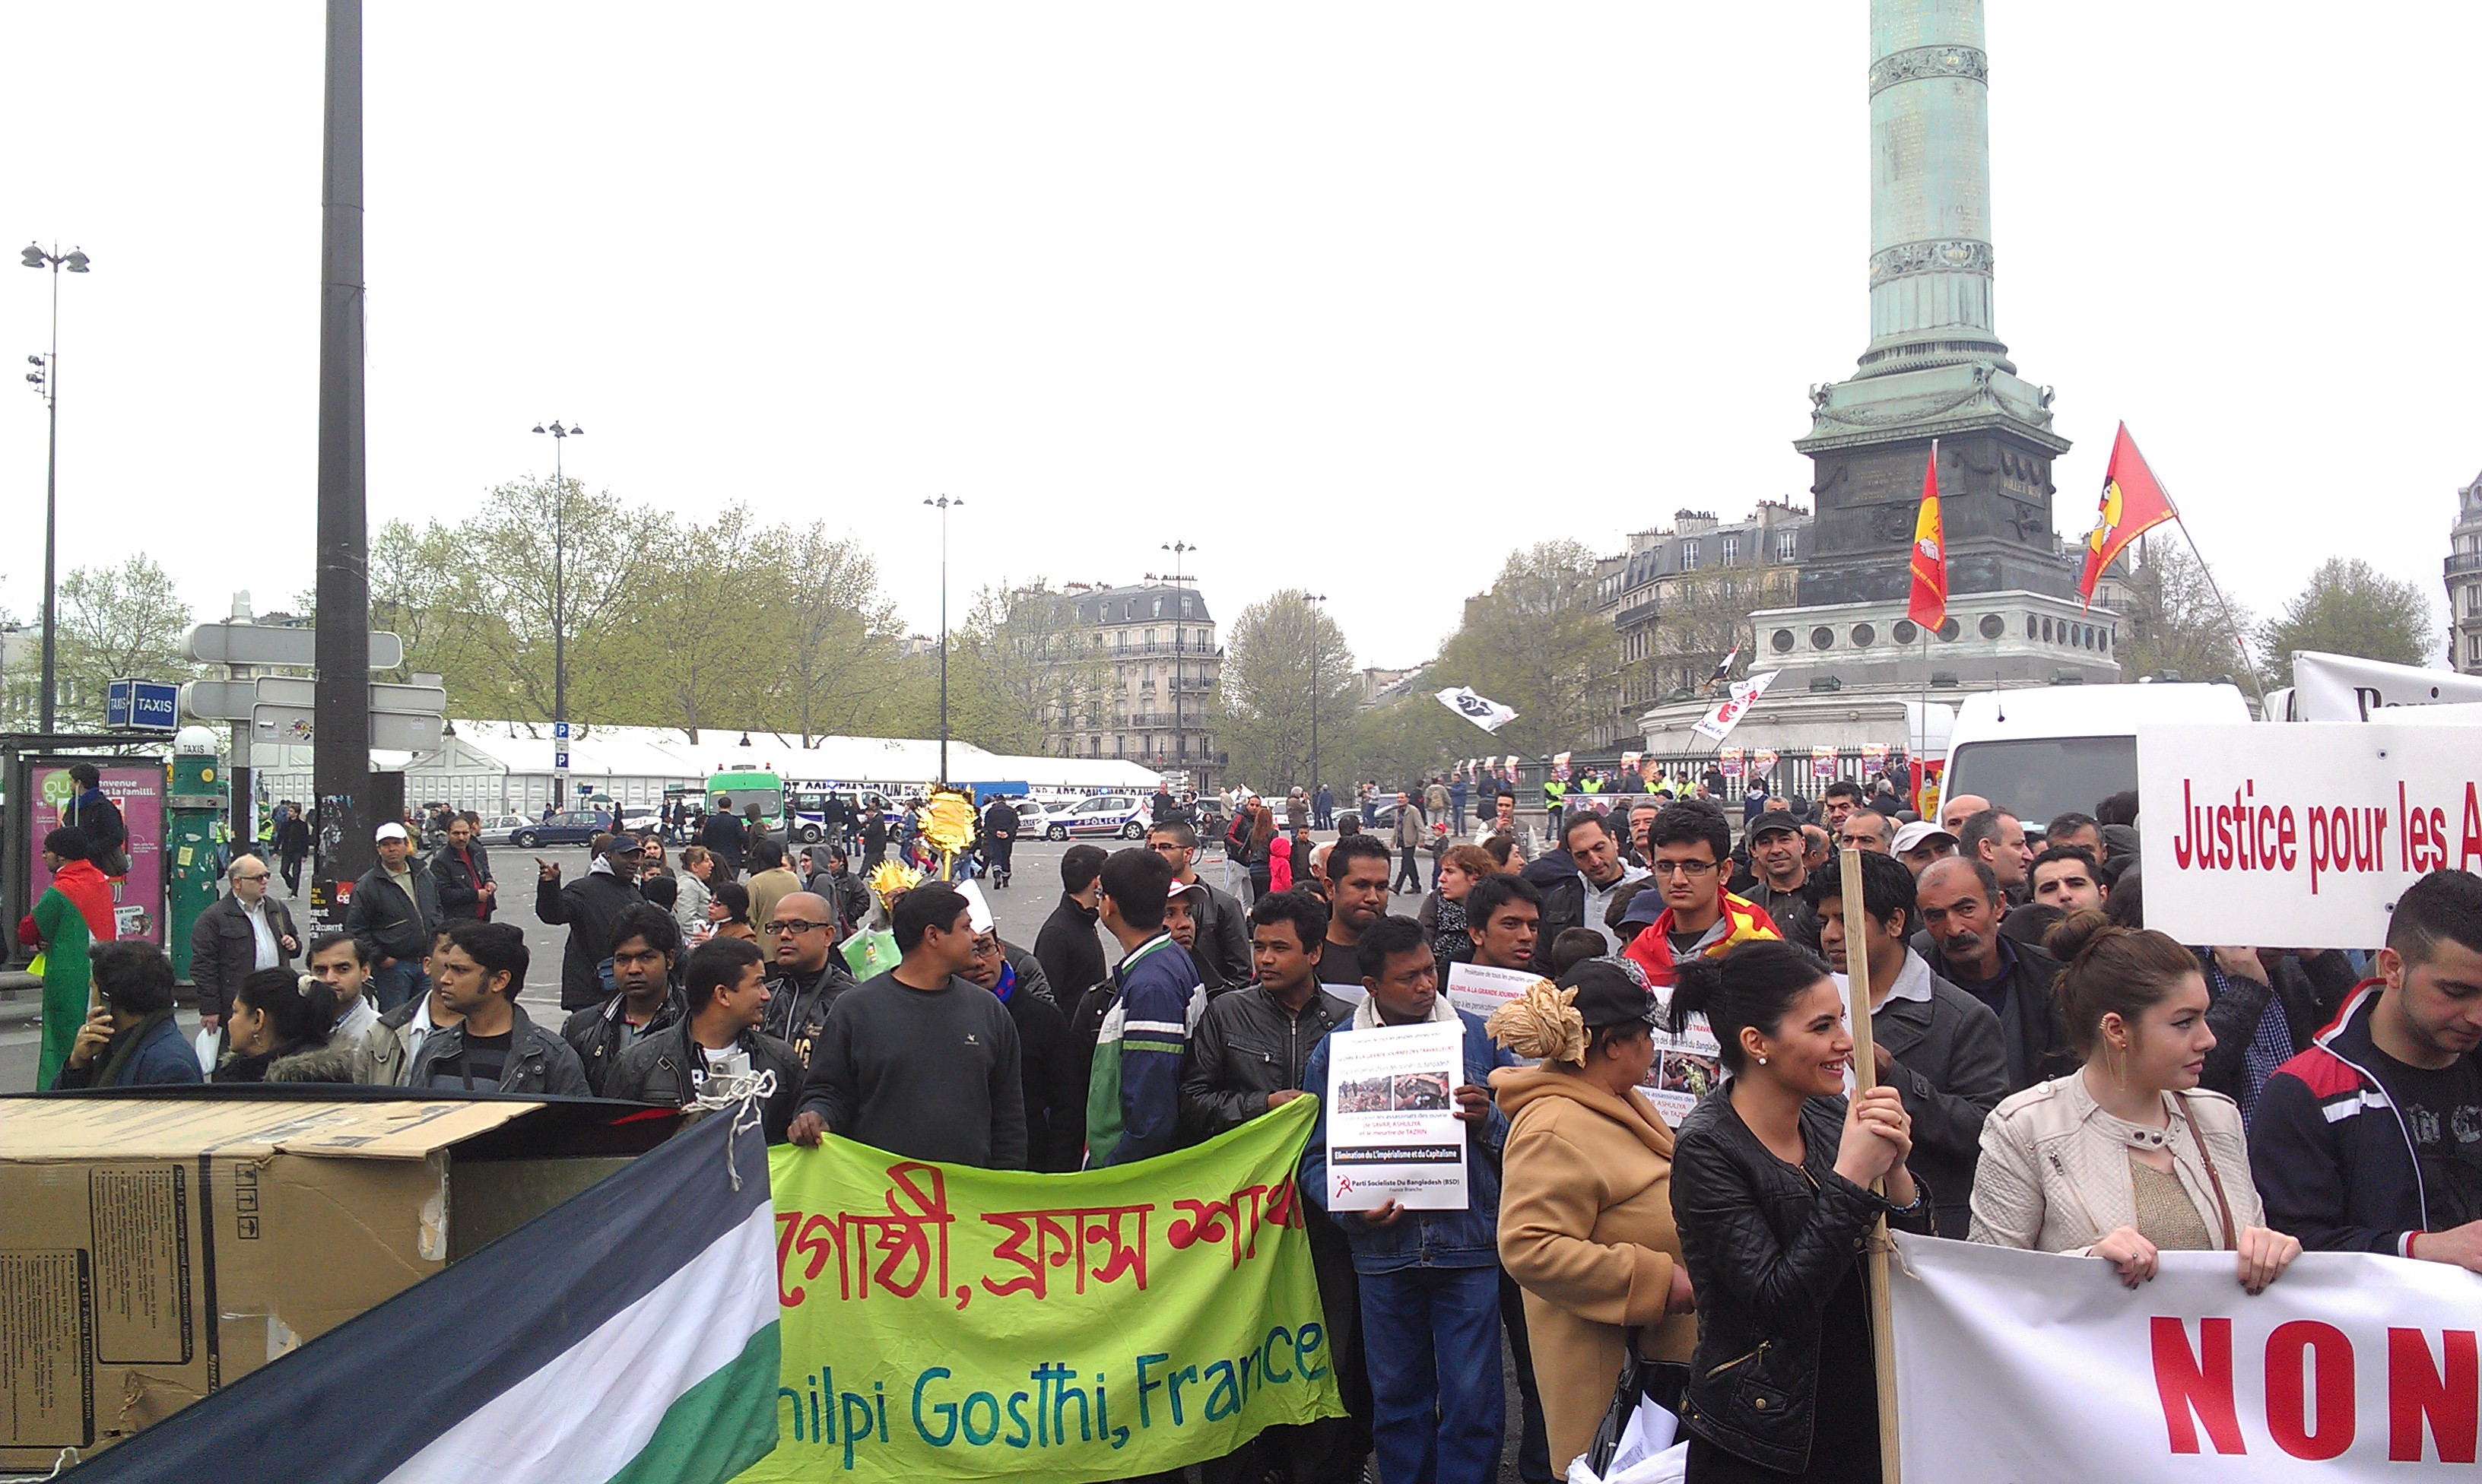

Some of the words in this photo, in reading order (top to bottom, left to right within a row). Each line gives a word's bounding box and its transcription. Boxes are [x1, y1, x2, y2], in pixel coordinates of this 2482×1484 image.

[110, 697, 126, 710] TAXIS
[137, 699, 172, 712] TAXIS
[559, 725, 566, 735] P
[183, 744, 205, 754] TAXIS
[558, 755, 566, 766] P
[1084, 817, 1121, 826] POLICE
[2174, 778, 2296, 870] Justice
[2308, 804, 2388, 895] pour
[2398, 780, 2448, 872] les
[1417, 1149, 1425, 1158] du
[1425, 1149, 1457, 1160] Capitalisme
[1406, 1178, 1442, 1187] Bangladesh
[912, 1362, 1130, 1450] Gosthi,
[1137, 1322, 1327, 1429] France
[2150, 1316, 2478, 1463] NON
